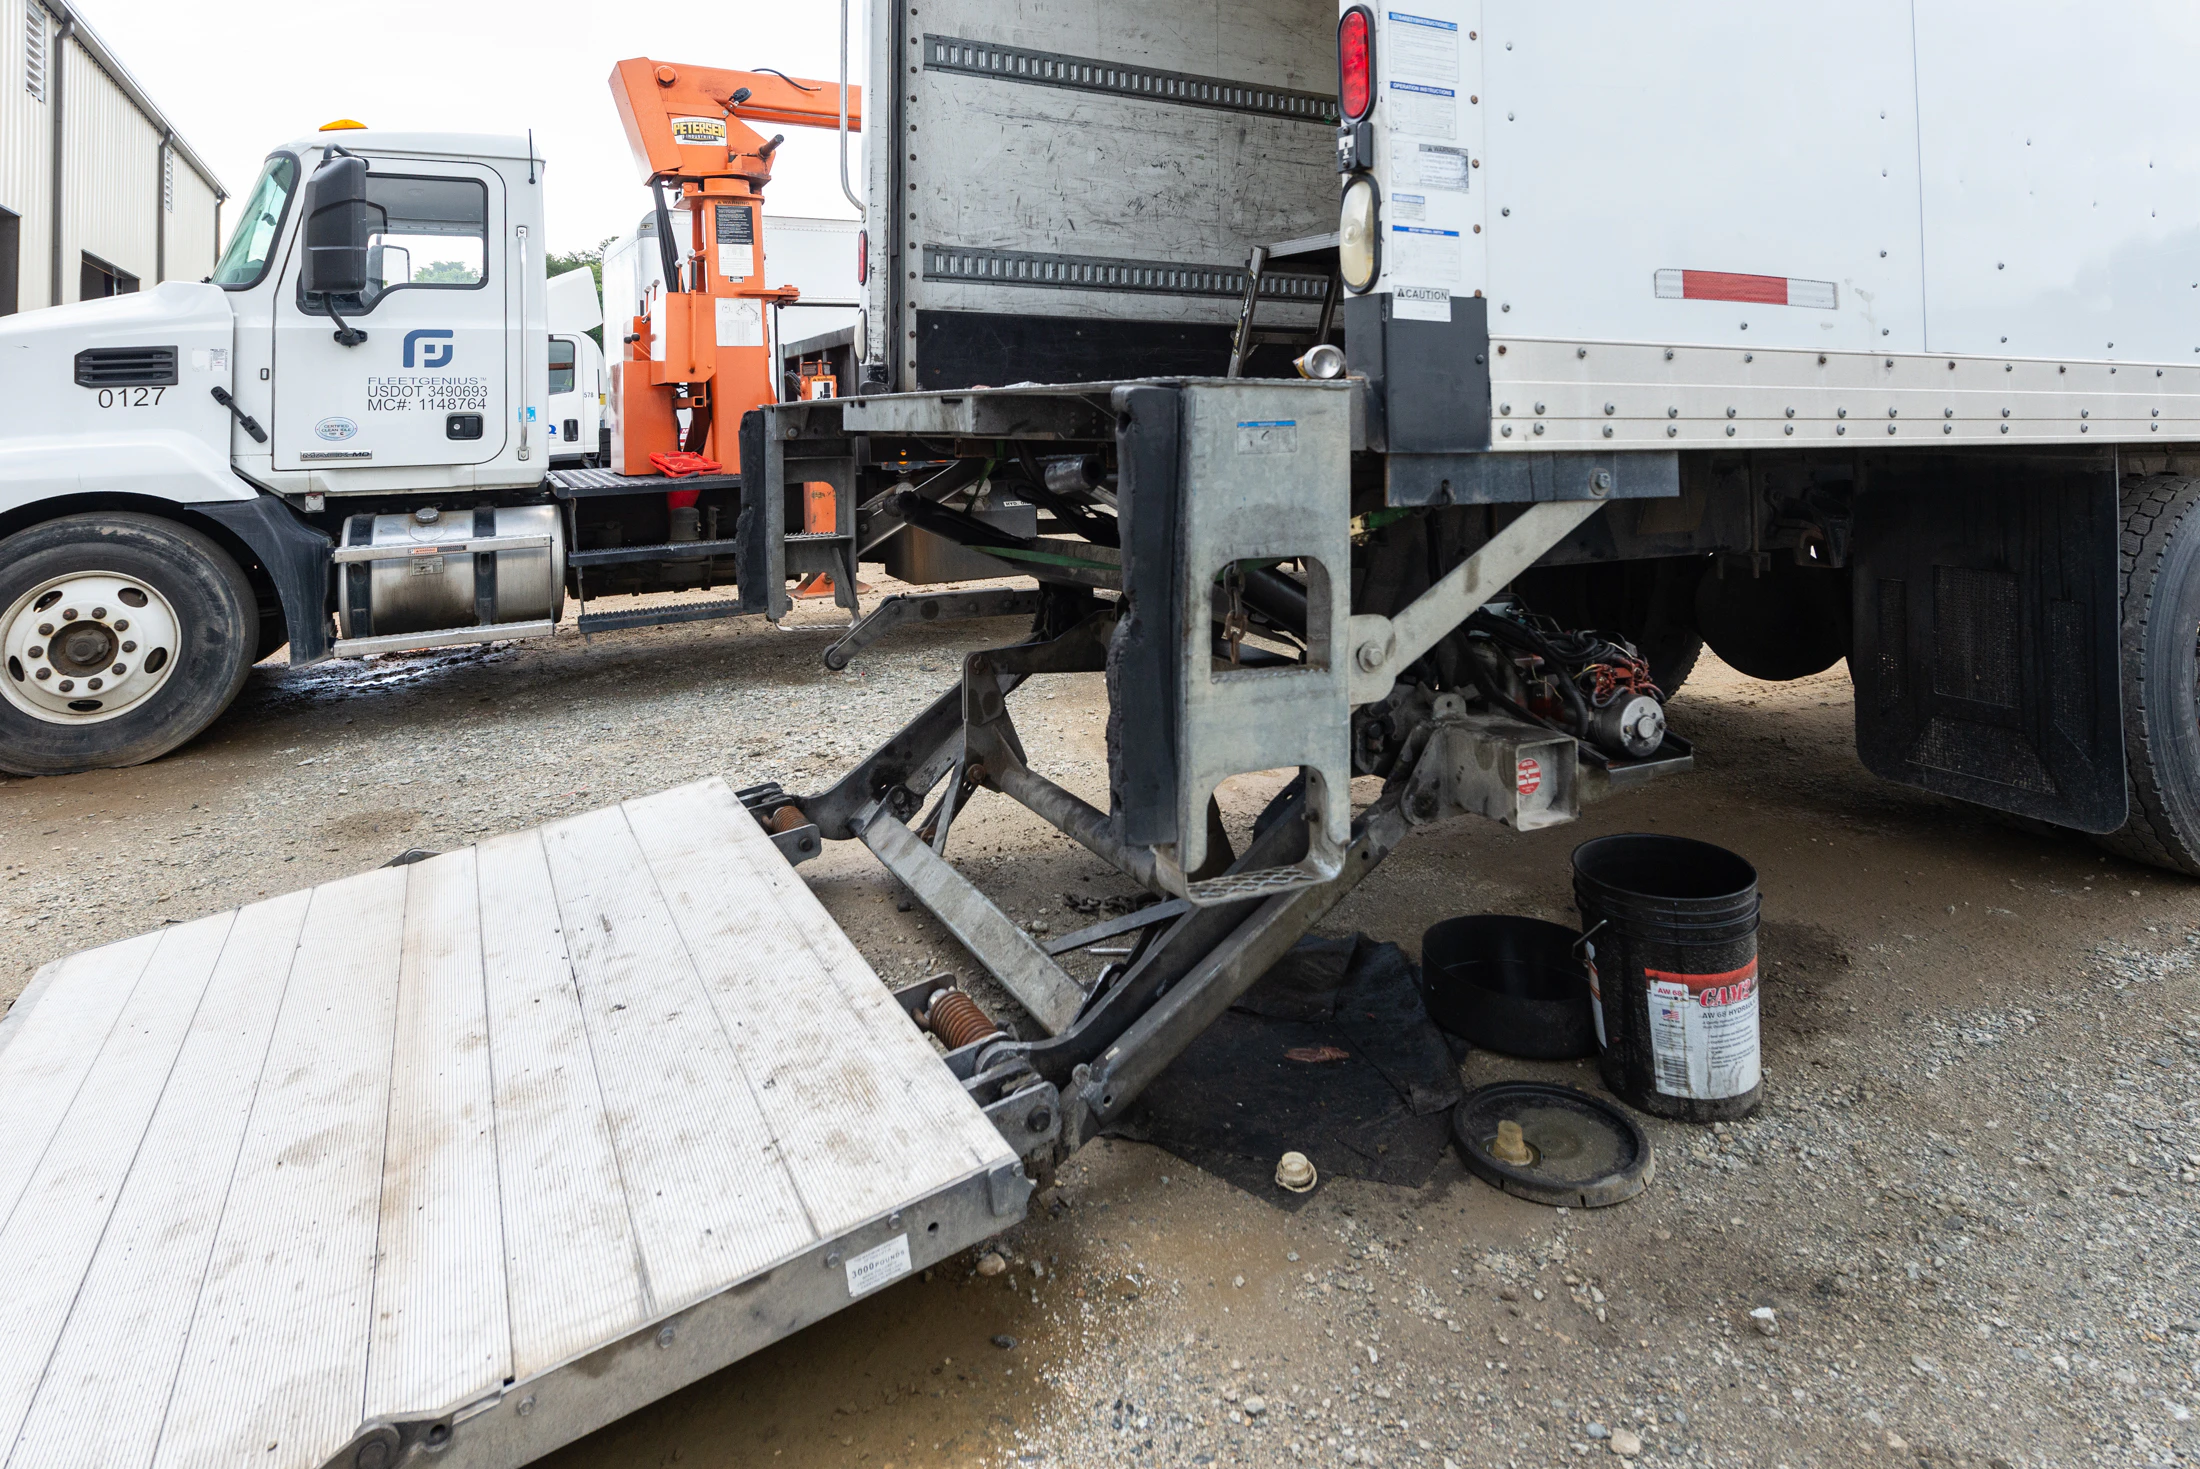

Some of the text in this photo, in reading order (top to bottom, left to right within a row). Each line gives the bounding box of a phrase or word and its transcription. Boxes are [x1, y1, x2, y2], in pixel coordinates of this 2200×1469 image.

[1393, 82, 1452, 96] OPERATION INSTRUCTIONS
[673, 121, 726, 138] PETERSEN
[1405, 288, 1448, 301] CAUTION
[98, 386, 167, 409] 0127
[367, 385, 488, 398] USDOT 3490693
[583, 391, 595, 399] 578
[367, 398, 487, 411] MC#: 1148764
[1657, 987, 1683, 997] AW 68
[1699, 978, 1751, 1009] CAM2
[1716, 1010, 1727, 1018] 68
[852, 1261, 875, 1280] 3000
[875, 1250, 906, 1268] POUNDS
